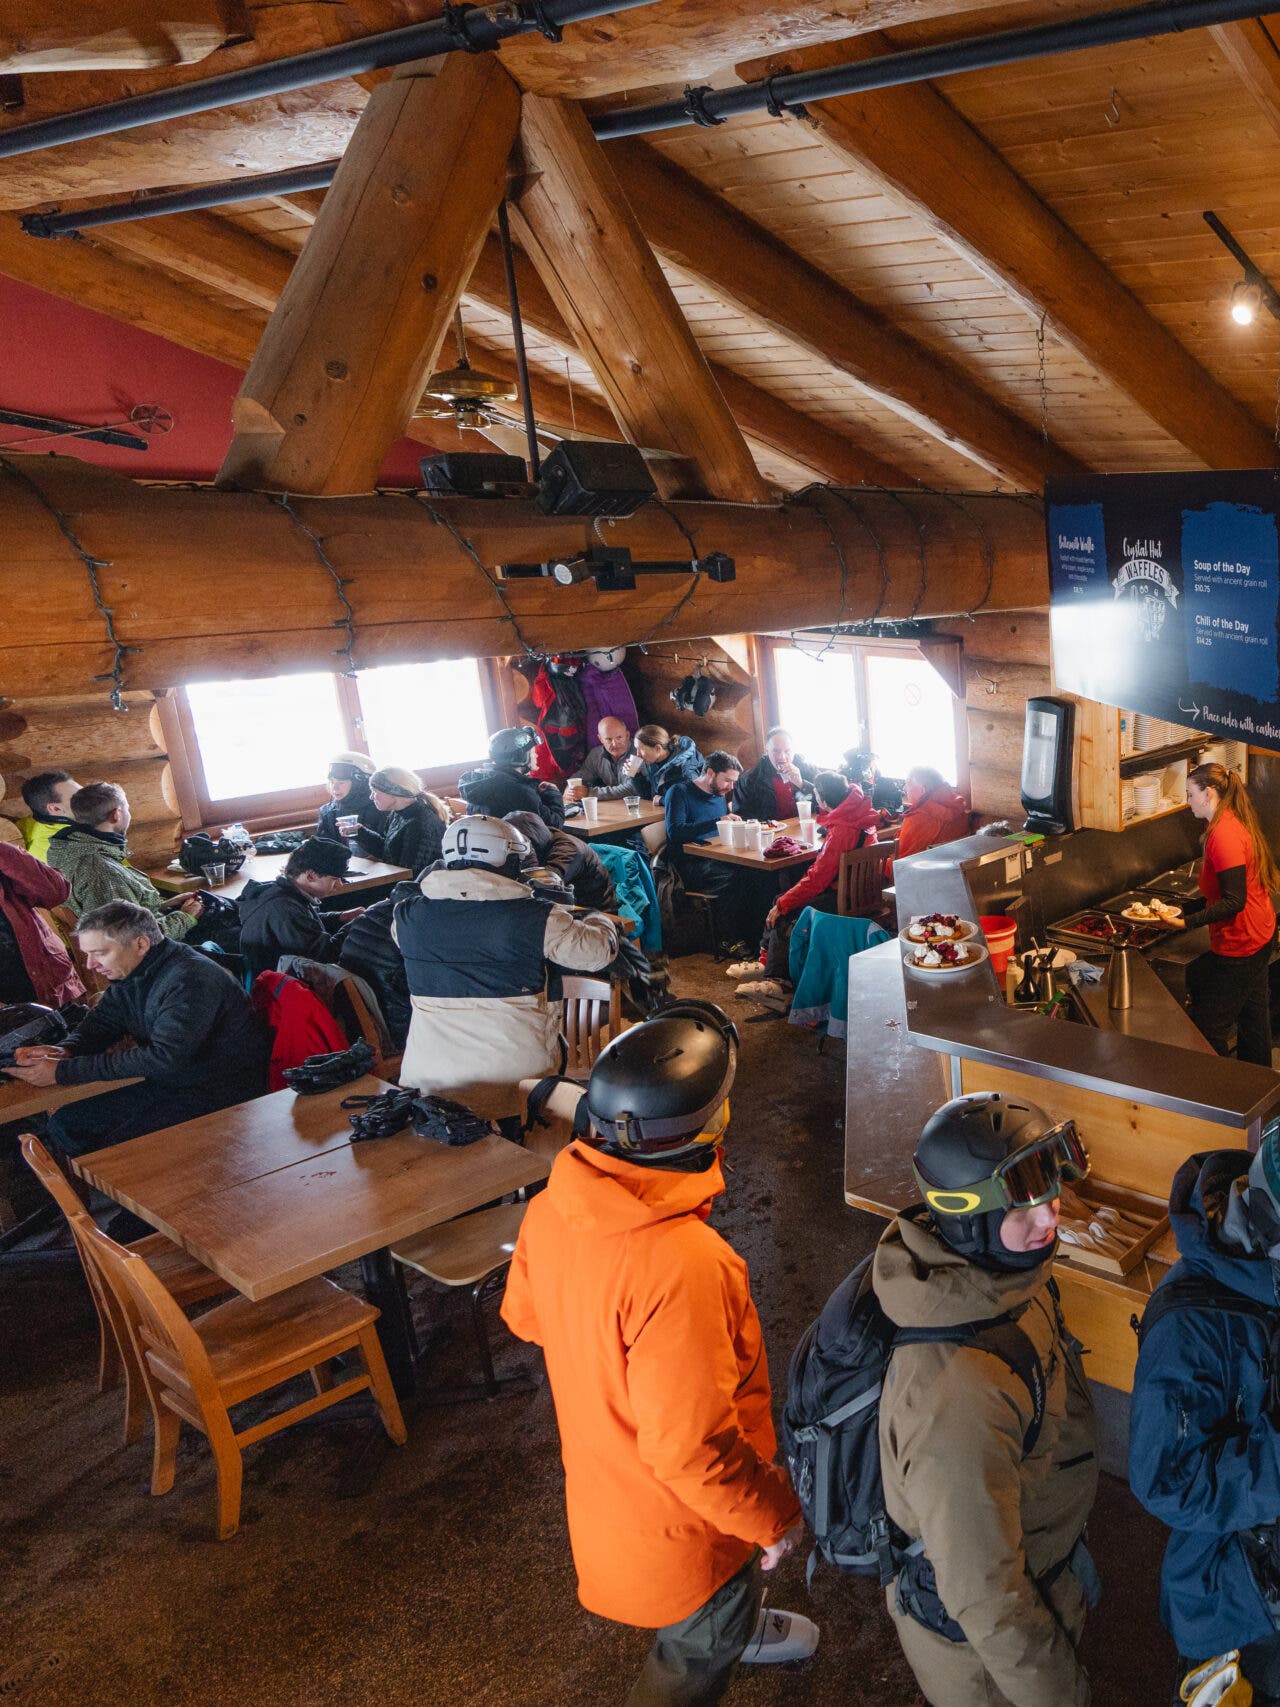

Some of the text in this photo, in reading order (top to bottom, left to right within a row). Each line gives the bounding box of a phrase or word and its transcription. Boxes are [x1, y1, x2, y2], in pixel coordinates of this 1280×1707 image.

[1123, 537, 1163, 561] Crystal Hut
[1125, 561, 1165, 584] WAFFLES
[1194, 560, 1250, 576] Soup of the Day
[1194, 574, 1211, 582] Served
[1224, 577, 1243, 585] ancient
[1243, 579, 1257, 587] grain
[1258, 580, 1267, 588] roll
[1195, 615, 1249, 633] Chili of the Day
[1196, 627, 1212, 636] Served
[1244, 636, 1259, 644] grain
[1259, 637, 1268, 645] roll
[1203, 705, 1220, 722] Place
[1240, 716, 1255, 733] with
